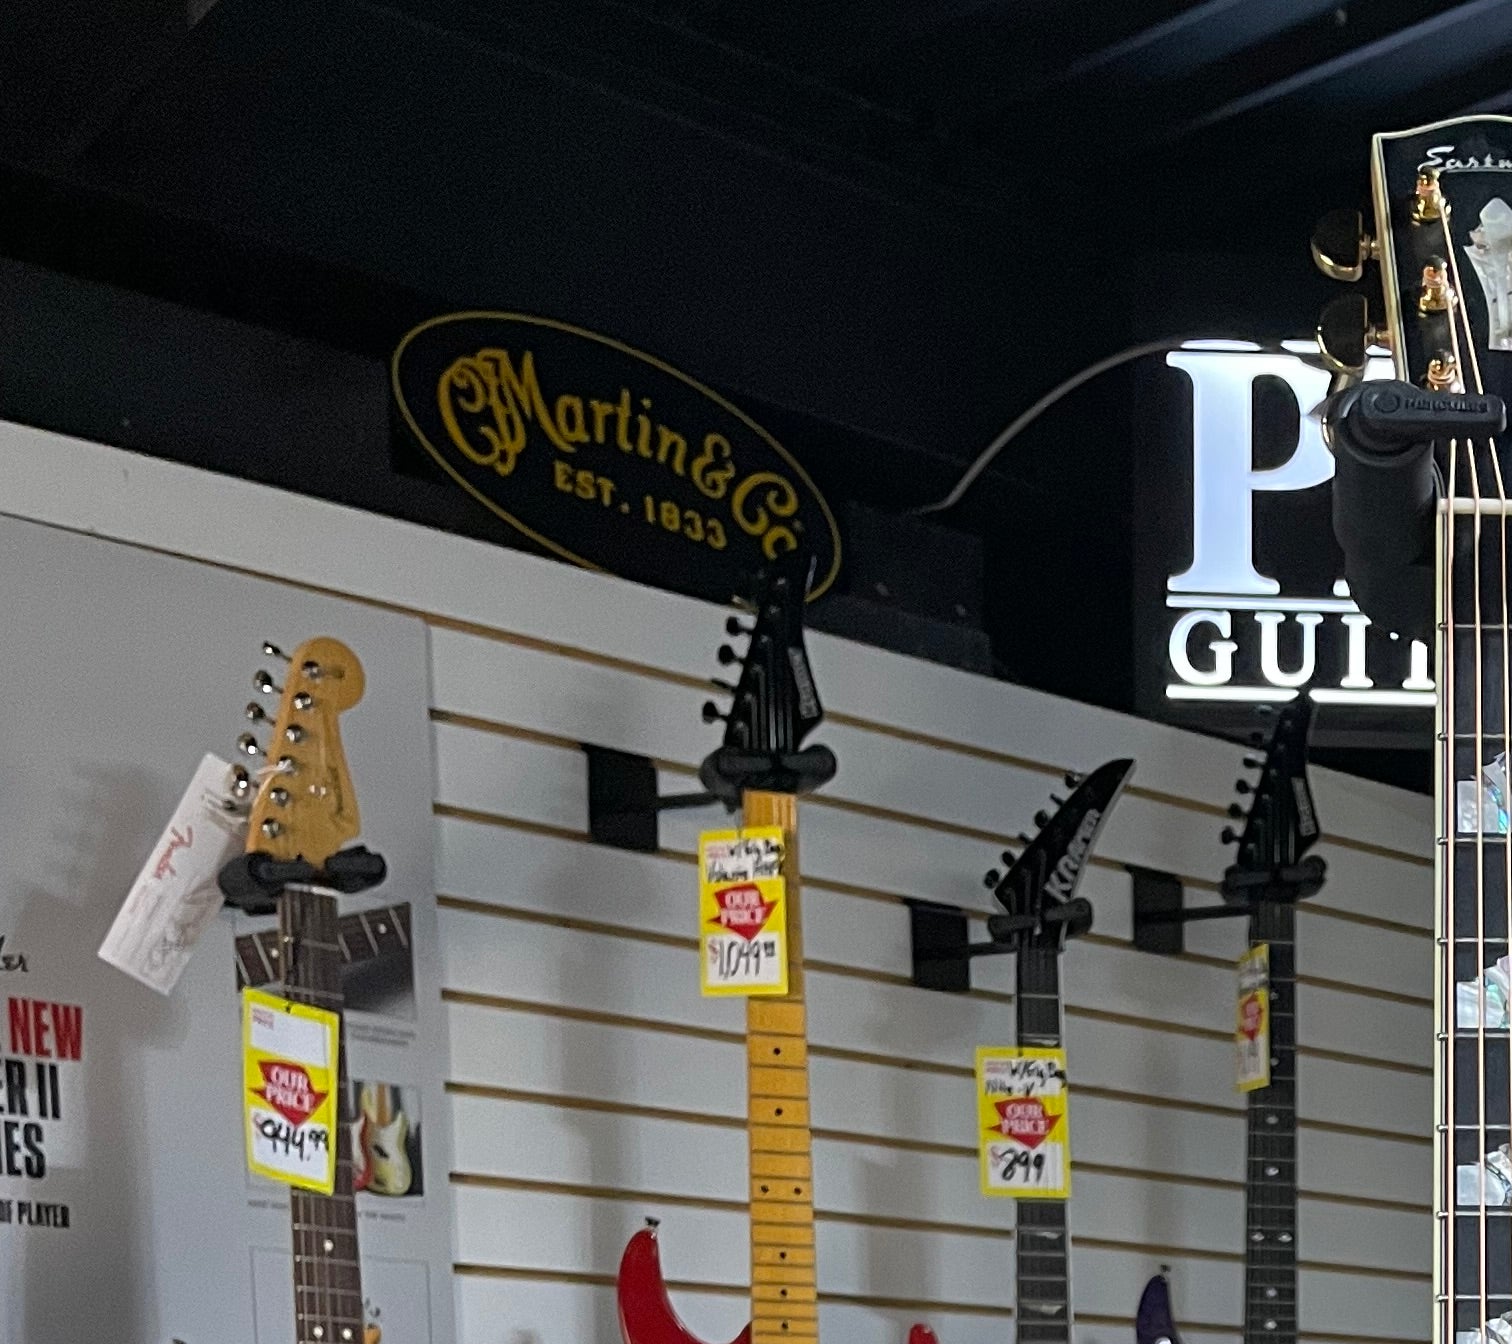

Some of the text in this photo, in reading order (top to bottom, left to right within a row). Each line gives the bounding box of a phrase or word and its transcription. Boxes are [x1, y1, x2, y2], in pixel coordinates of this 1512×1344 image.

[554, 458, 728, 551] EST. 1833
[9, 997, 83, 1062] NEW
[271, 1065, 309, 1092] OUR
[1004, 1103, 1043, 1120] OUR
